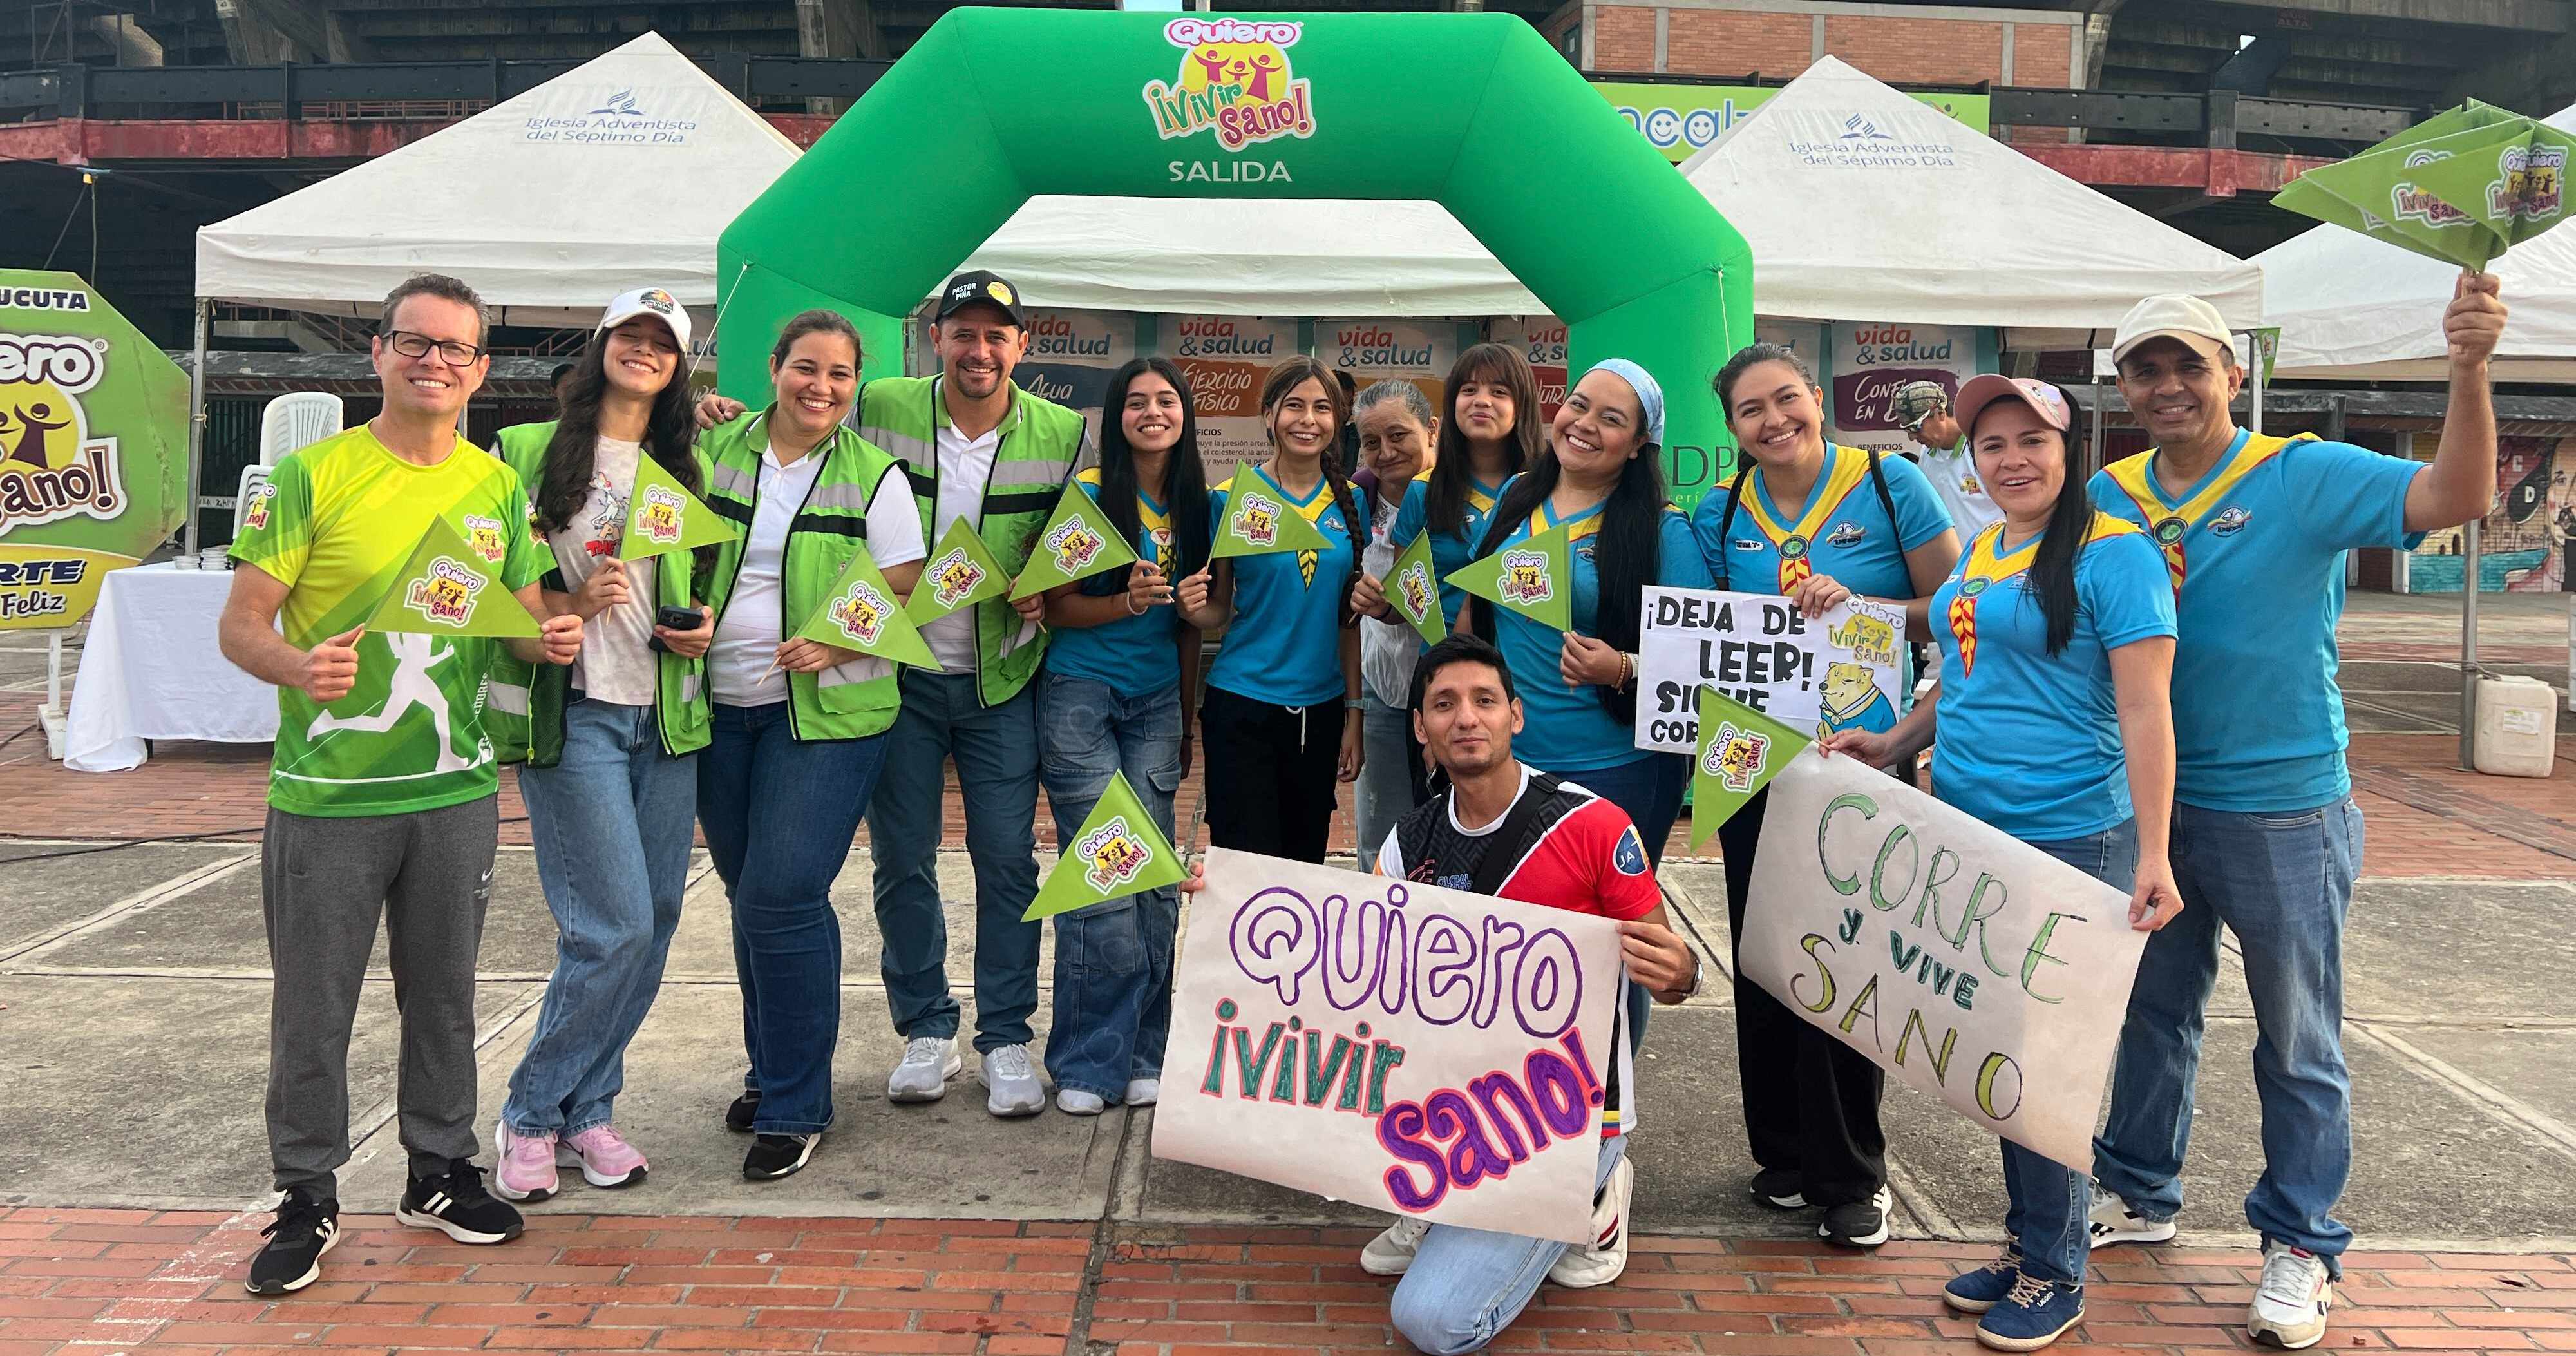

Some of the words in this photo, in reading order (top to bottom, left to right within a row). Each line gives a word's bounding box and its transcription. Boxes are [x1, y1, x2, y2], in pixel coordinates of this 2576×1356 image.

[1168, 19, 1297, 46] Quiero
[525, 117, 588, 129] Iglesia
[592, 118, 696, 129] Adventista
[1219, 87, 1309, 144] Sano!
[526, 129, 558, 140] del
[562, 131, 645, 143] Séptimo
[652, 131, 685, 143] Día
[1788, 141, 1850, 155] Iglesia
[1855, 142, 1953, 155] Adventista
[1168, 160, 1293, 182] SALIDA
[1803, 155, 1833, 166] del
[1841, 155, 1917, 167] Séptimo
[1923, 155, 1953, 167] Día
[952, 282, 977, 296] PASTOR
[1179, 316, 1235, 337] vida
[1338, 325, 1394, 347] vida
[1855, 323, 1912, 345] vida
[1037, 332, 1112, 355] salud
[1179, 337, 1198, 356] &
[1201, 333, 1274, 354] salud
[1338, 347, 1357, 367] &
[1360, 343, 1433, 366] salud
[1528, 343, 1546, 364] &
[1855, 345, 1877, 365] &
[1879, 339, 1952, 361] salud
[1855, 404, 1875, 421] EN
[1222, 440, 1249, 448] presión
[0, 450, 114, 513] ano!
[648, 489, 681, 510] Quiero
[1245, 496, 1277, 516] Quiero
[465, 515, 500, 531] Quiero
[1050, 519, 1081, 548] Quiero
[931, 551, 962, 580] Quiero
[1506, 555, 1543, 568] Quiero
[435, 562, 478, 590] Quiero
[1, 591, 64, 616] Feliz
[854, 586, 887, 615] Quiero
[1846, 595, 1906, 629] Quiero
[1647, 595, 1734, 634] ¡DEJA
[1762, 604, 1806, 635] DE
[1700, 639, 1815, 691] LEER!
[1855, 645, 1897, 667] Sano!
[1707, 729, 1734, 770] Quiero
[1082, 824, 1122, 857] Quiero
[1620, 850, 1635, 868] JA
[1817, 793, 2088, 1004] CORRE
[1889, 930, 1980, 1011] VIVE
[1790, 933, 2023, 1121] SANO
